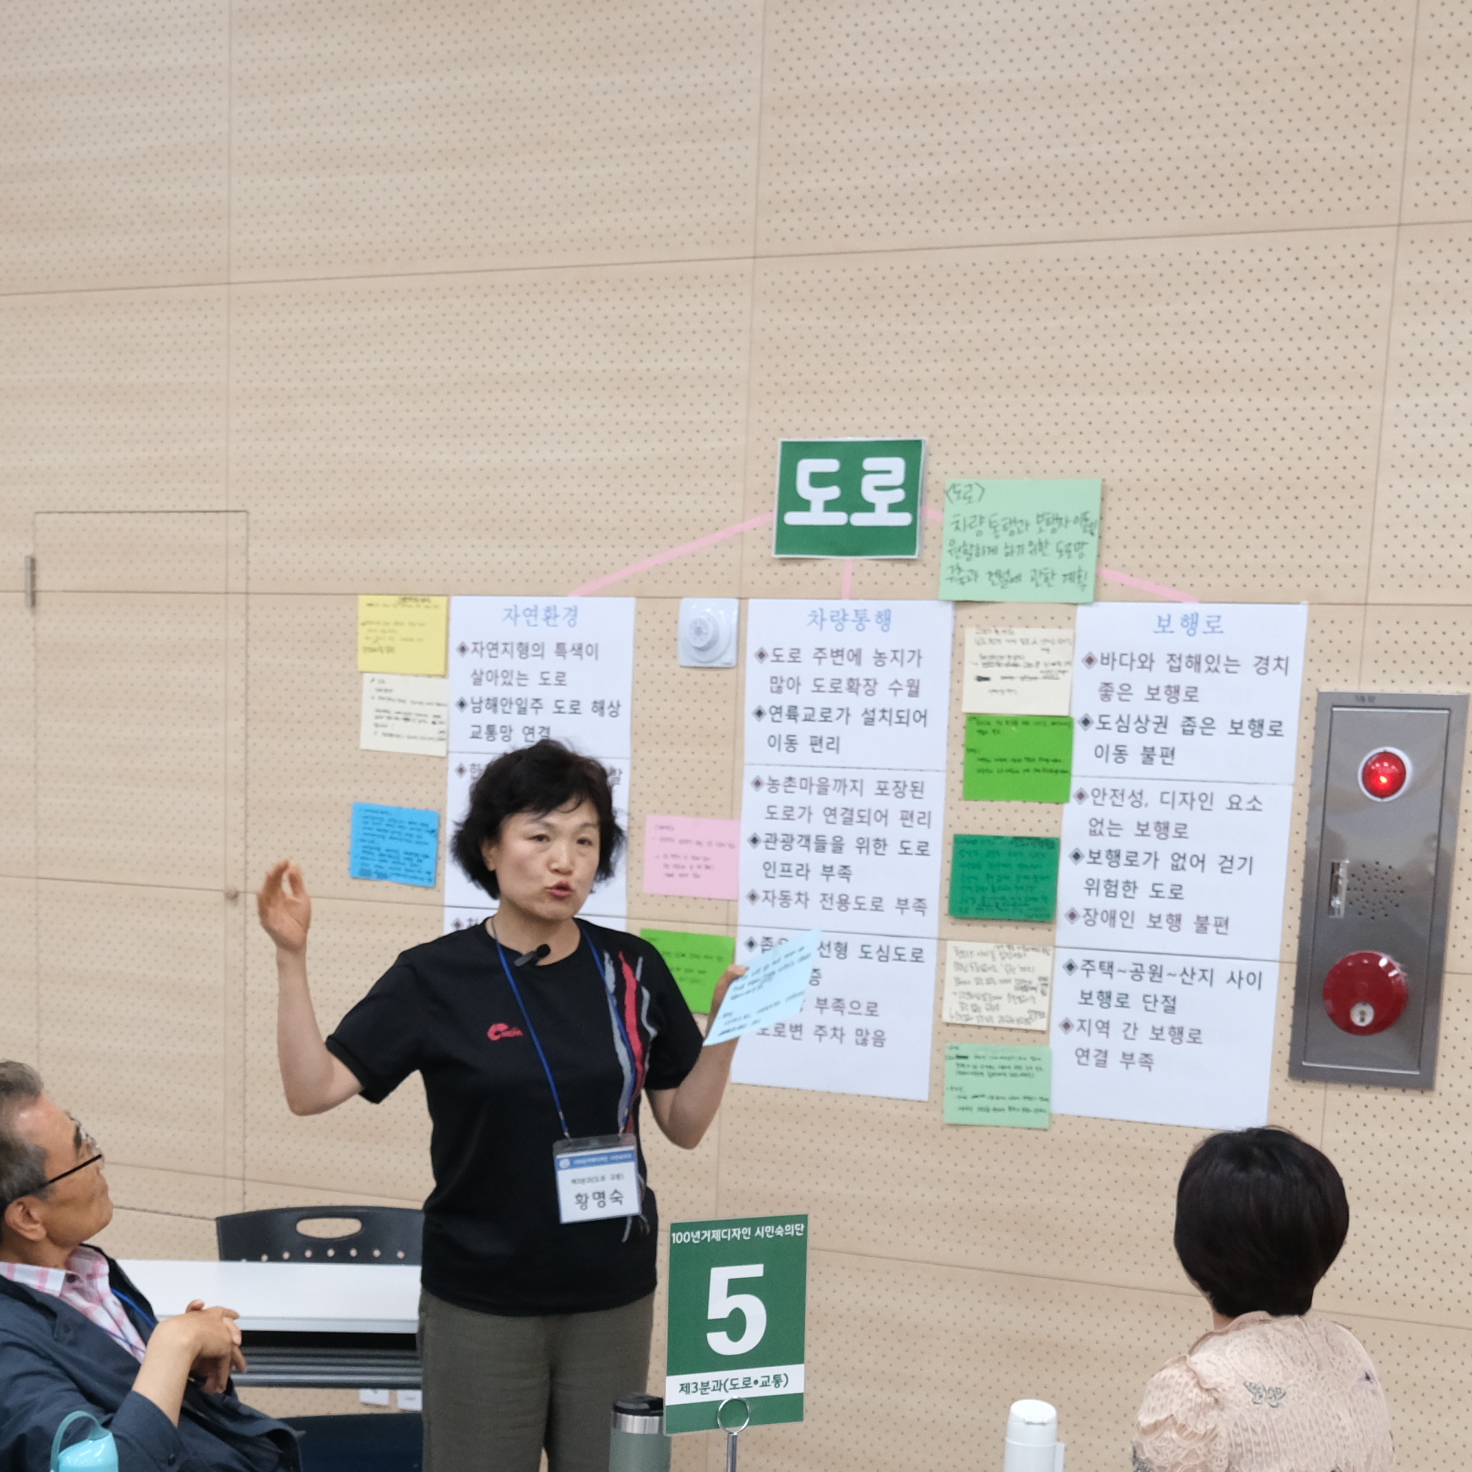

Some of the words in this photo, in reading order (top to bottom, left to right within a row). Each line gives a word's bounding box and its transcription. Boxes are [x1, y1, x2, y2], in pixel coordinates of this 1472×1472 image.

[784, 457, 913, 525] 도로
[503, 605, 578, 627] 자연환경
[807, 608, 892, 632] 차량통행
[1153, 612, 1224, 637] 보행로
[471, 641, 545, 660] 자연지형의
[554, 642, 599, 661] 특색이
[770, 647, 802, 664] 도로
[812, 647, 862, 666] 주변에
[873, 648, 923, 667] 농지가
[1100, 651, 1154, 672] 바다와
[1166, 653, 1241, 674] 접해있는
[1253, 655, 1289, 676] 경치
[471, 669, 529, 687] 살아있는
[538, 671, 567, 686] 도로
[769, 675, 801, 694] 많아
[811, 676, 878, 696] 도로확장
[888, 678, 920, 697] 수월
[1098, 681, 1133, 703] 좋은
[1145, 684, 1199, 704] 보행로
[470, 697, 544, 715] 남해안일주
[552, 699, 582, 715] 도로
[591, 699, 621, 718] 해상
[769, 705, 851, 725] 연륙교로가
[861, 707, 927, 728] 설치되어
[469, 724, 513, 742] 교통망
[1096, 713, 1168, 735] 도심상권
[1181, 716, 1216, 736] 좁은
[1228, 718, 1284, 738] 보행로
[767, 734, 799, 753] 이동
[809, 734, 840, 754] 편리
[1094, 744, 1128, 764] 이동
[1140, 745, 1175, 766] 불편
[766, 775, 864, 796] 농촌마을까지
[875, 780, 924, 799] 포장된
[1091, 787, 1148, 809] 안전성,
[1160, 790, 1214, 812] 디자인
[1226, 794, 1263, 812] 요소
[765, 805, 812, 823] 도로가
[823, 806, 888, 826] 연결되어
[899, 809, 932, 828] 편리
[1089, 818, 1123, 837] 없는
[1135, 820, 1189, 840] 보행로
[763, 833, 845, 854] 관광객들을
[856, 836, 888, 856] 위한
[898, 840, 930, 856] 도로
[763, 861, 810, 881] 인프라
[820, 864, 852, 883] 부족
[1086, 848, 1159, 870] 보행로가
[1170, 852, 1205, 872] 없어
[1218, 855, 1253, 875] 걷기
[1084, 878, 1139, 899] 위험한
[1149, 882, 1184, 900] 도로
[761, 890, 810, 909] 자동차
[819, 892, 884, 913] 전용도로
[895, 897, 928, 916] 부족
[1082, 907, 1134, 929] 장애인
[1147, 912, 1182, 933] 보행
[1194, 914, 1229, 936] 불편
[817, 939, 848, 960] 선형
[858, 944, 924, 964] 도심도로
[1226, 970, 1263, 990] 사이
[815, 997, 880, 1017] 부족으로
[1078, 990, 1130, 1010] 보행로
[1143, 993, 1177, 1015] 단절
[814, 1025, 845, 1044] 주차
[856, 1028, 886, 1048] 많음
[1077, 1018, 1110, 1039] 지역
[1122, 1022, 1138, 1040] 간
[1149, 1025, 1203, 1045] 보행로
[1075, 1048, 1108, 1068] 연결
[1120, 1051, 1154, 1072] 부족
[672, 1227, 751, 1244] 100년거제디자인
[755, 1223, 805, 1238] 시민숙의단
[706, 1264, 767, 1355] 5
